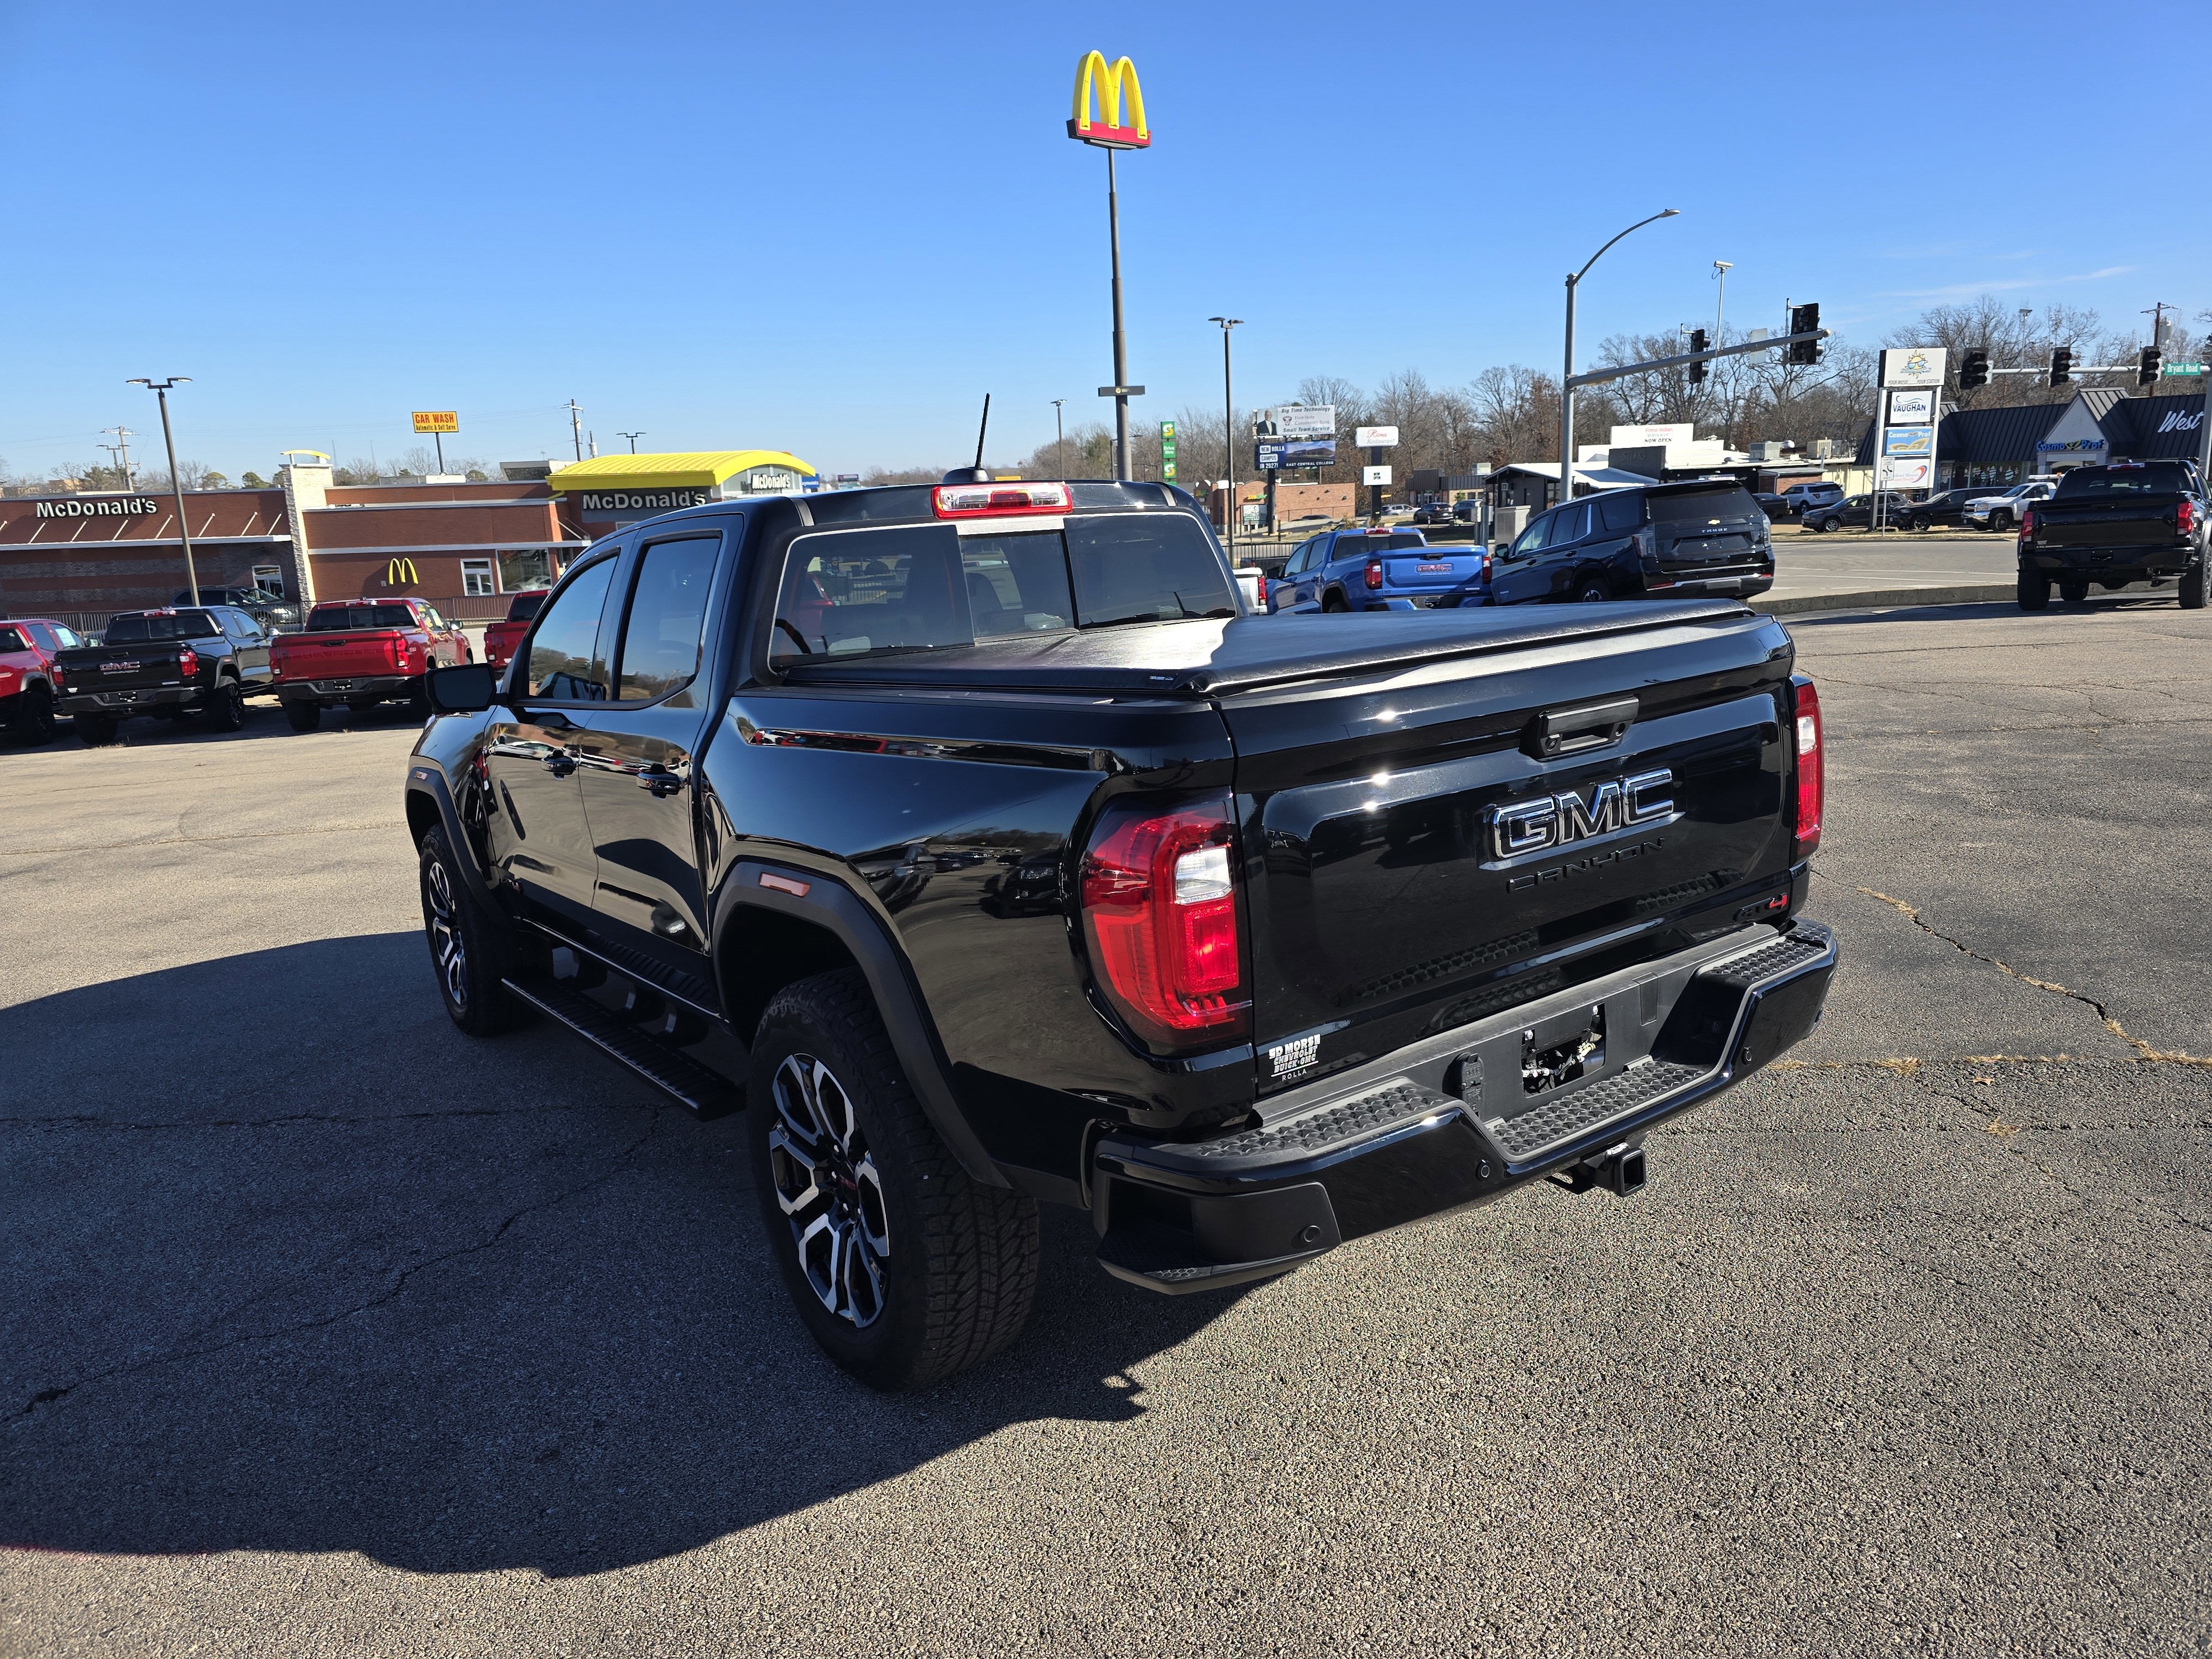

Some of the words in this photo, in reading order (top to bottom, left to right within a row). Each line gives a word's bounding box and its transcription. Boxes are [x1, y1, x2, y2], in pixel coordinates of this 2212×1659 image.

[2167, 364, 2184, 374] Bryant
[2185, 364, 2198, 372] Road
[1893, 404, 1926, 412] VAUGHAN
[415, 414, 430, 424] CAR
[432, 414, 454, 423] WASH
[2157, 410, 2204, 433] West
[2036, 441, 2066, 451] Cosmo
[2080, 440, 2104, 450] Prof
[752, 474, 791, 489] McDonald's
[36, 498, 158, 518] McDonald's
[583, 491, 706, 510] McDonald's
[1417, 564, 1452, 573] GMC
[100, 661, 140, 671] GMC
[1493, 766, 1674, 858] GMC
[1506, 837, 1666, 894] CANYON
[1269, 1046, 1284, 1060] ED
[1284, 1034, 1321, 1055] MORSE
[1274, 1045, 1318, 1066] CHEVROLET
[1282, 1068, 1307, 1082] ROLLA
